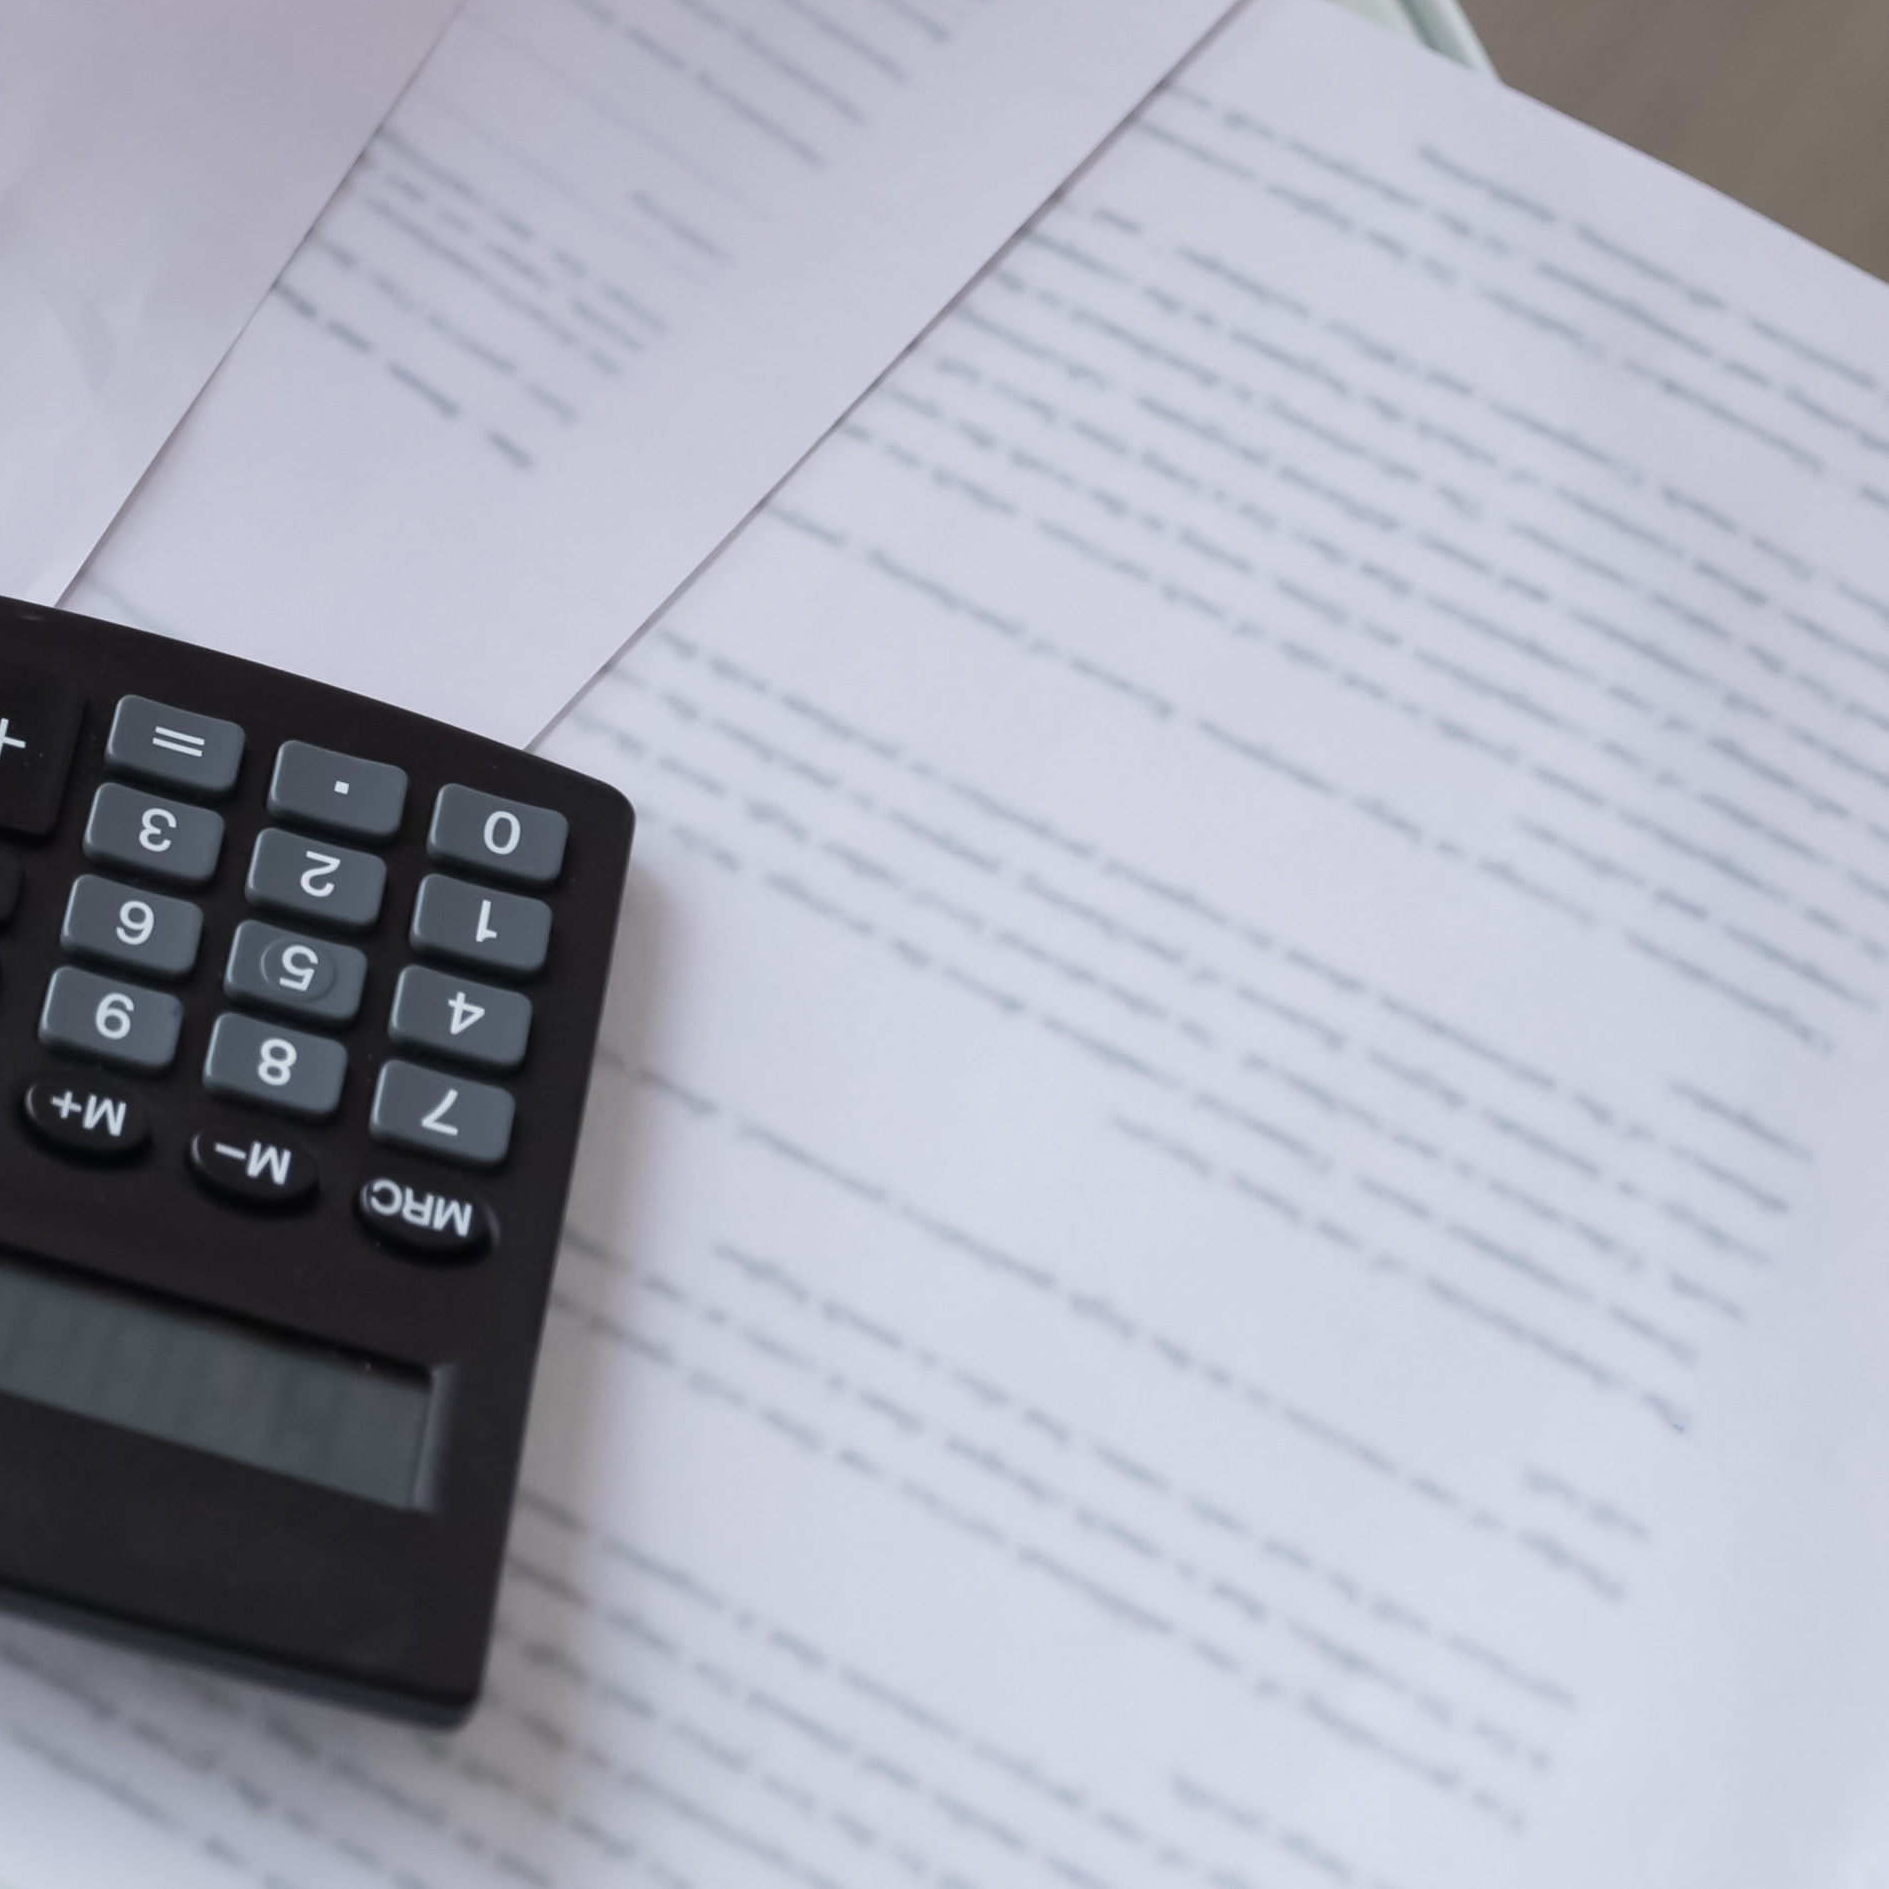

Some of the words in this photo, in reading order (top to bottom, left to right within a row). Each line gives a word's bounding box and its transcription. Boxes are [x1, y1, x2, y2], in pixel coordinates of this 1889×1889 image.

[137, 807, 178, 853] 3
[482, 809, 522, 856] 0
[299, 849, 342, 898] 2
[115, 899, 155, 946] 6
[474, 898, 498, 944] 1
[278, 944, 319, 992] 5
[94, 992, 135, 1041] 9
[447, 990, 486, 1036] 4
[257, 1037, 298, 1087] 8
[51, 1090, 128, 1141] M+
[420, 1088, 459, 1137] 7
[369, 1178, 473, 1237] MRC
